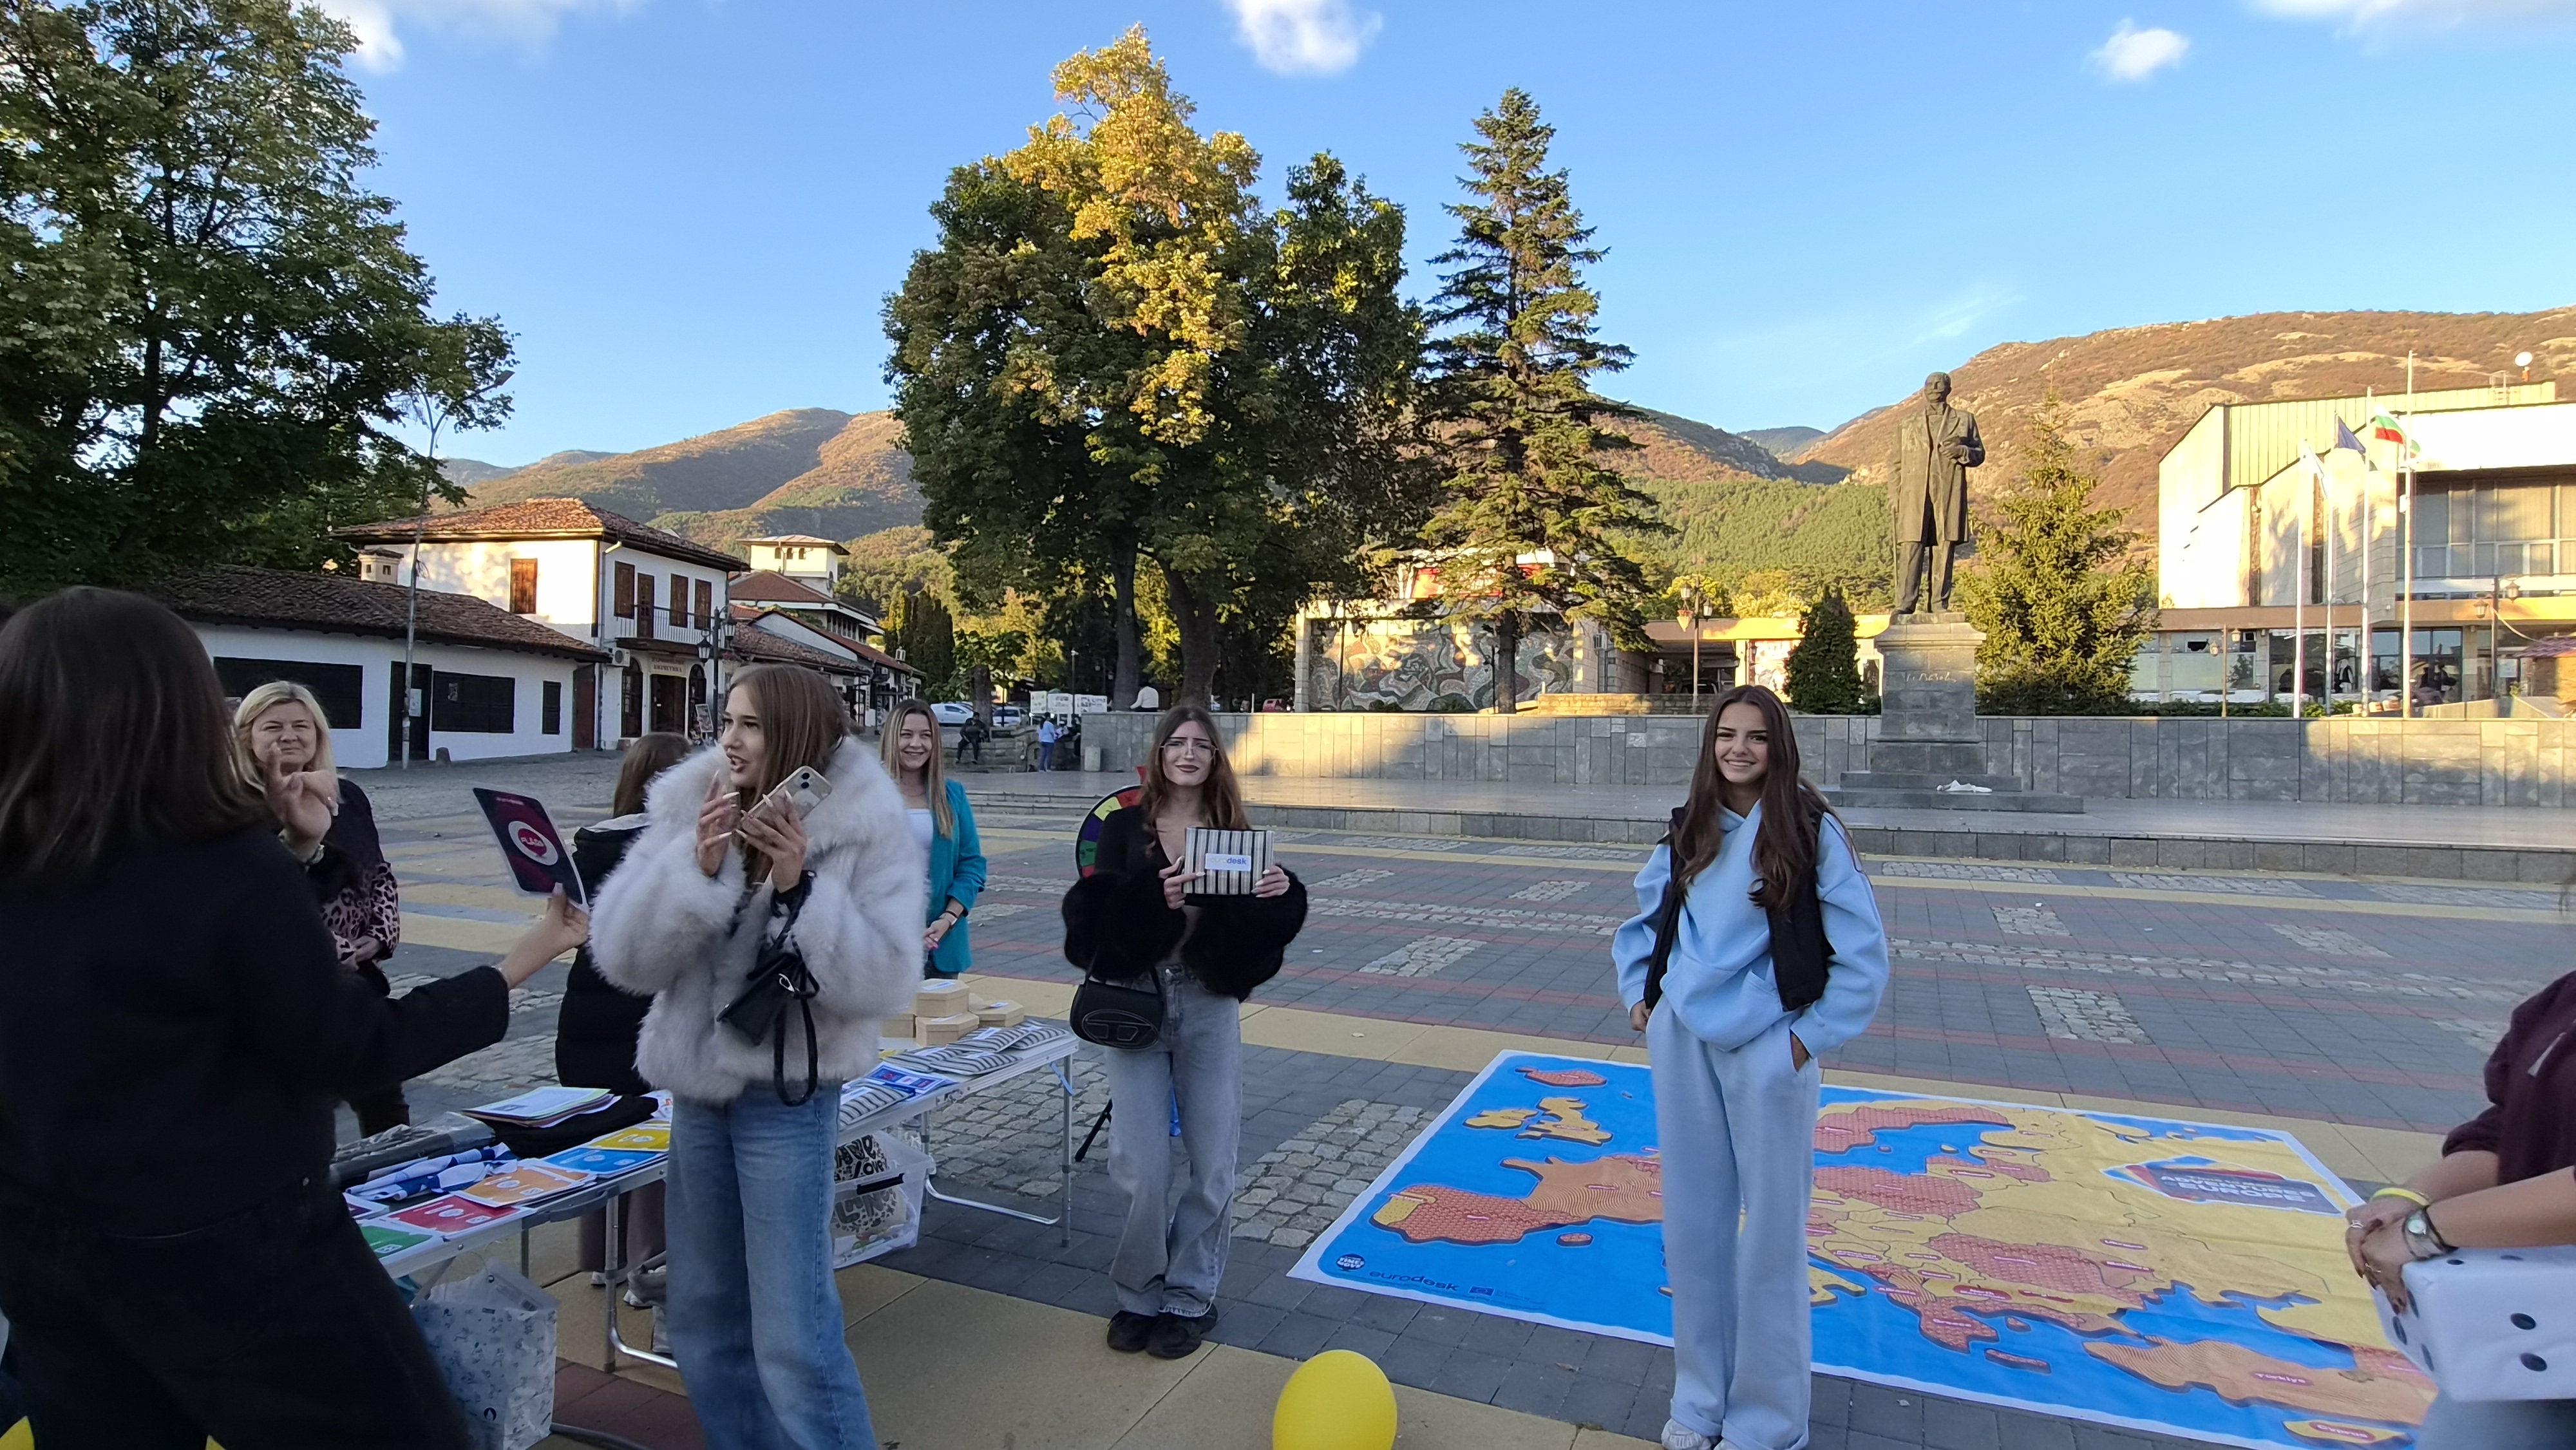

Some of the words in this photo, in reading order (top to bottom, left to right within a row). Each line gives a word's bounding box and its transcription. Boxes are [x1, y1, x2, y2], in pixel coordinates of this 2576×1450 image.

[2161, 1175, 2316, 1197] ADVENTURES
[2178, 1182, 2306, 1202] EUROPE
[1369, 1271, 1461, 1292] eurodesk
[2316, 1424, 2369, 1438] Cyprus
